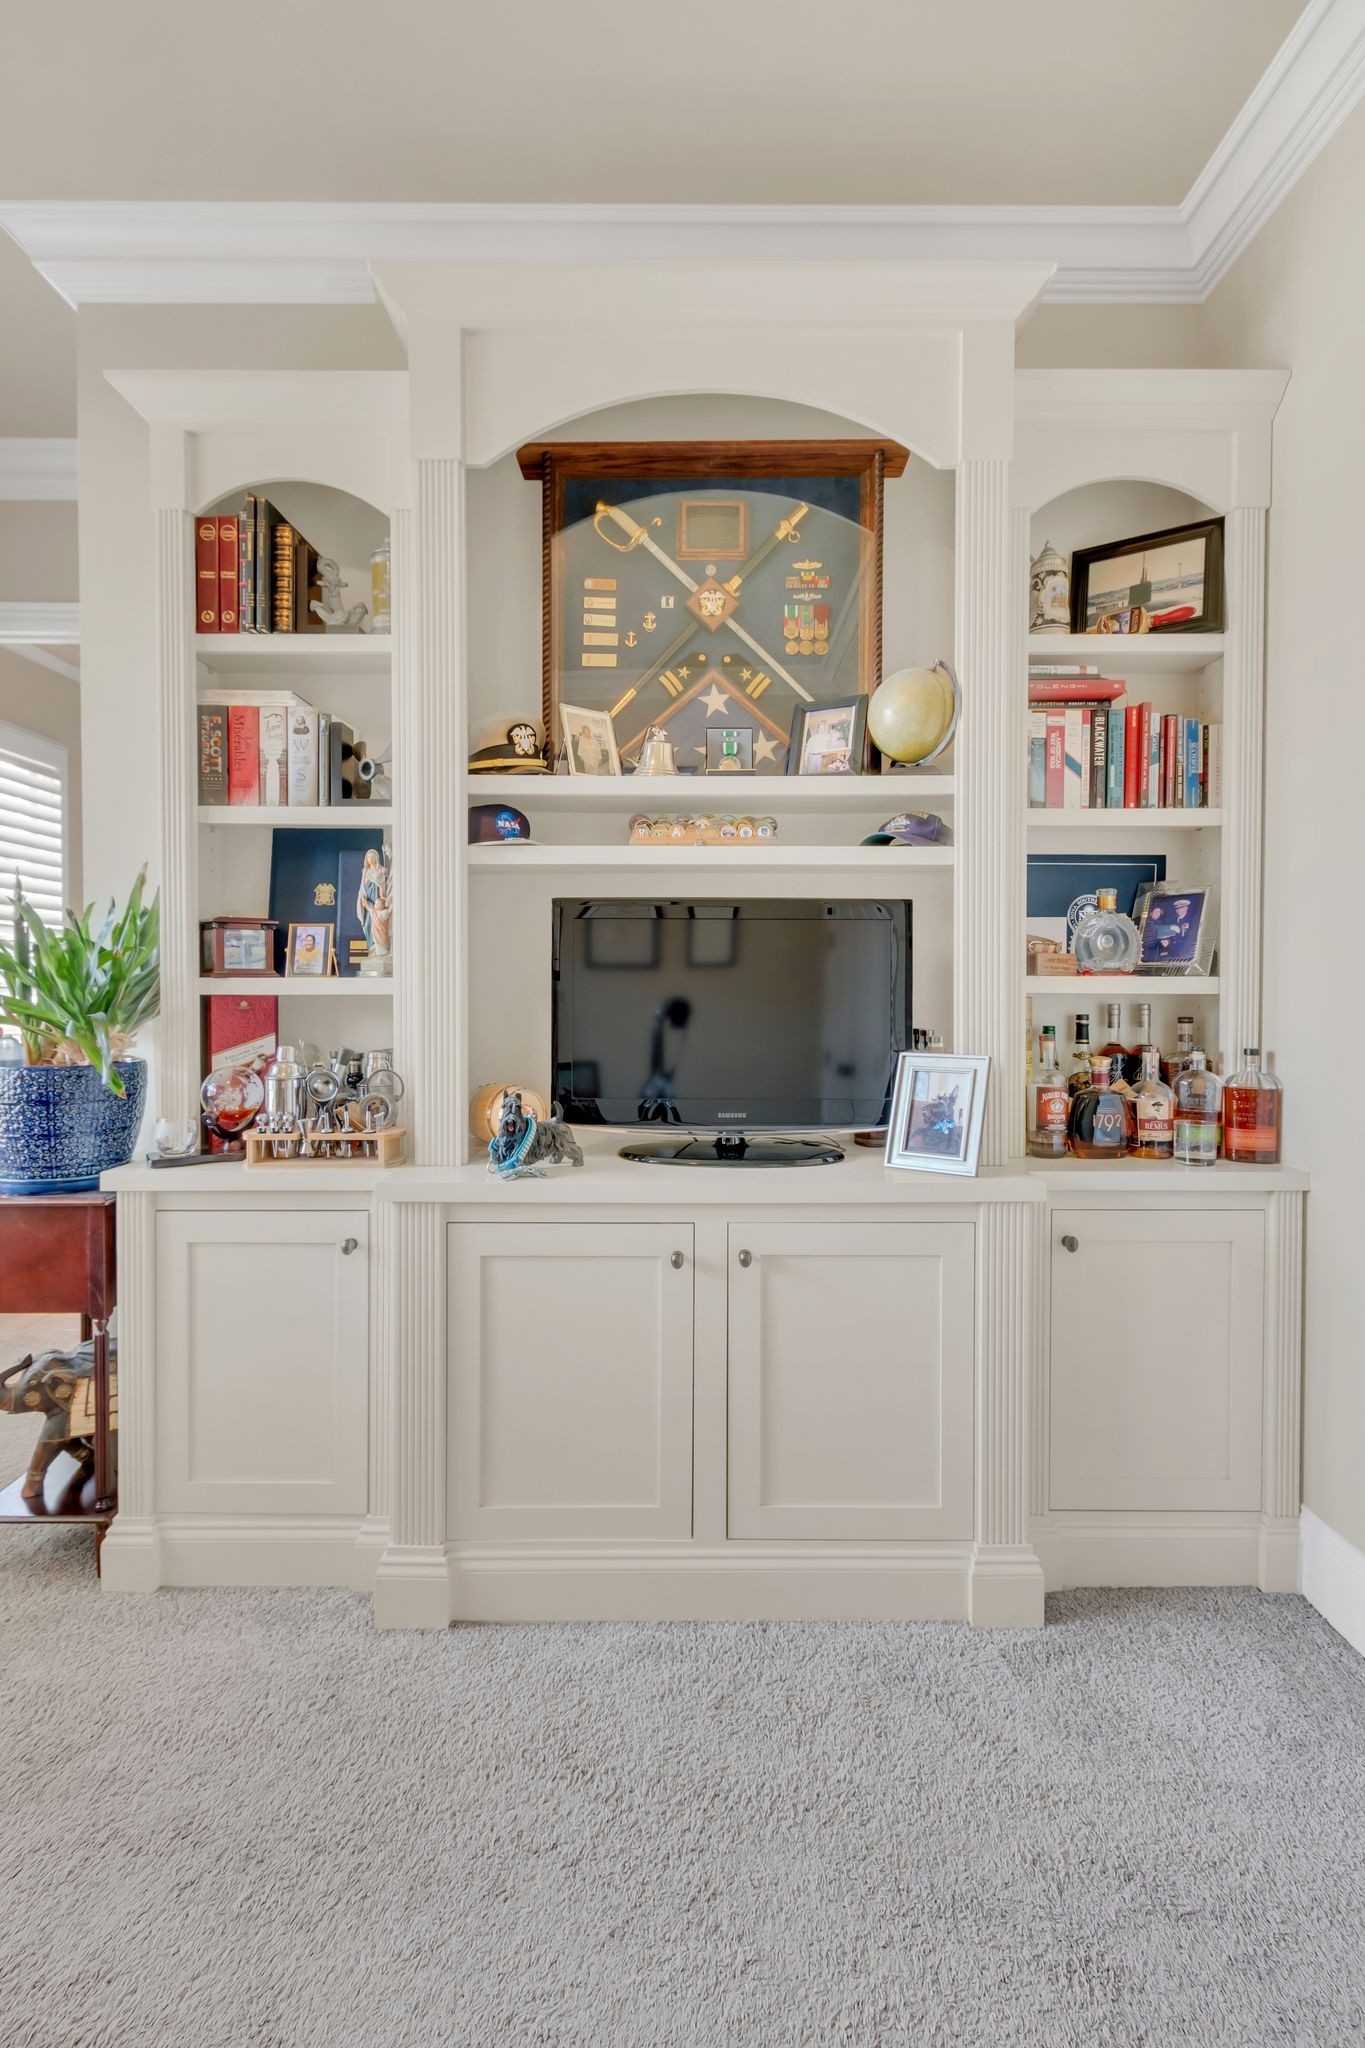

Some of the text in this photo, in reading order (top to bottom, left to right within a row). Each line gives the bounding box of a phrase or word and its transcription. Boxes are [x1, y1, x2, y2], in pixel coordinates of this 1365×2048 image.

[201, 715, 211, 773] FITZGERALD
[210, 730, 223, 773] SCOTT
[232, 714, 247, 772] Misérables
[1094, 716, 1105, 766] BLACKWATER
[1151, 734, 1159, 753] GOAL
[498, 820, 520, 830] NASA
[1092, 1114, 1122, 1132] 1792
